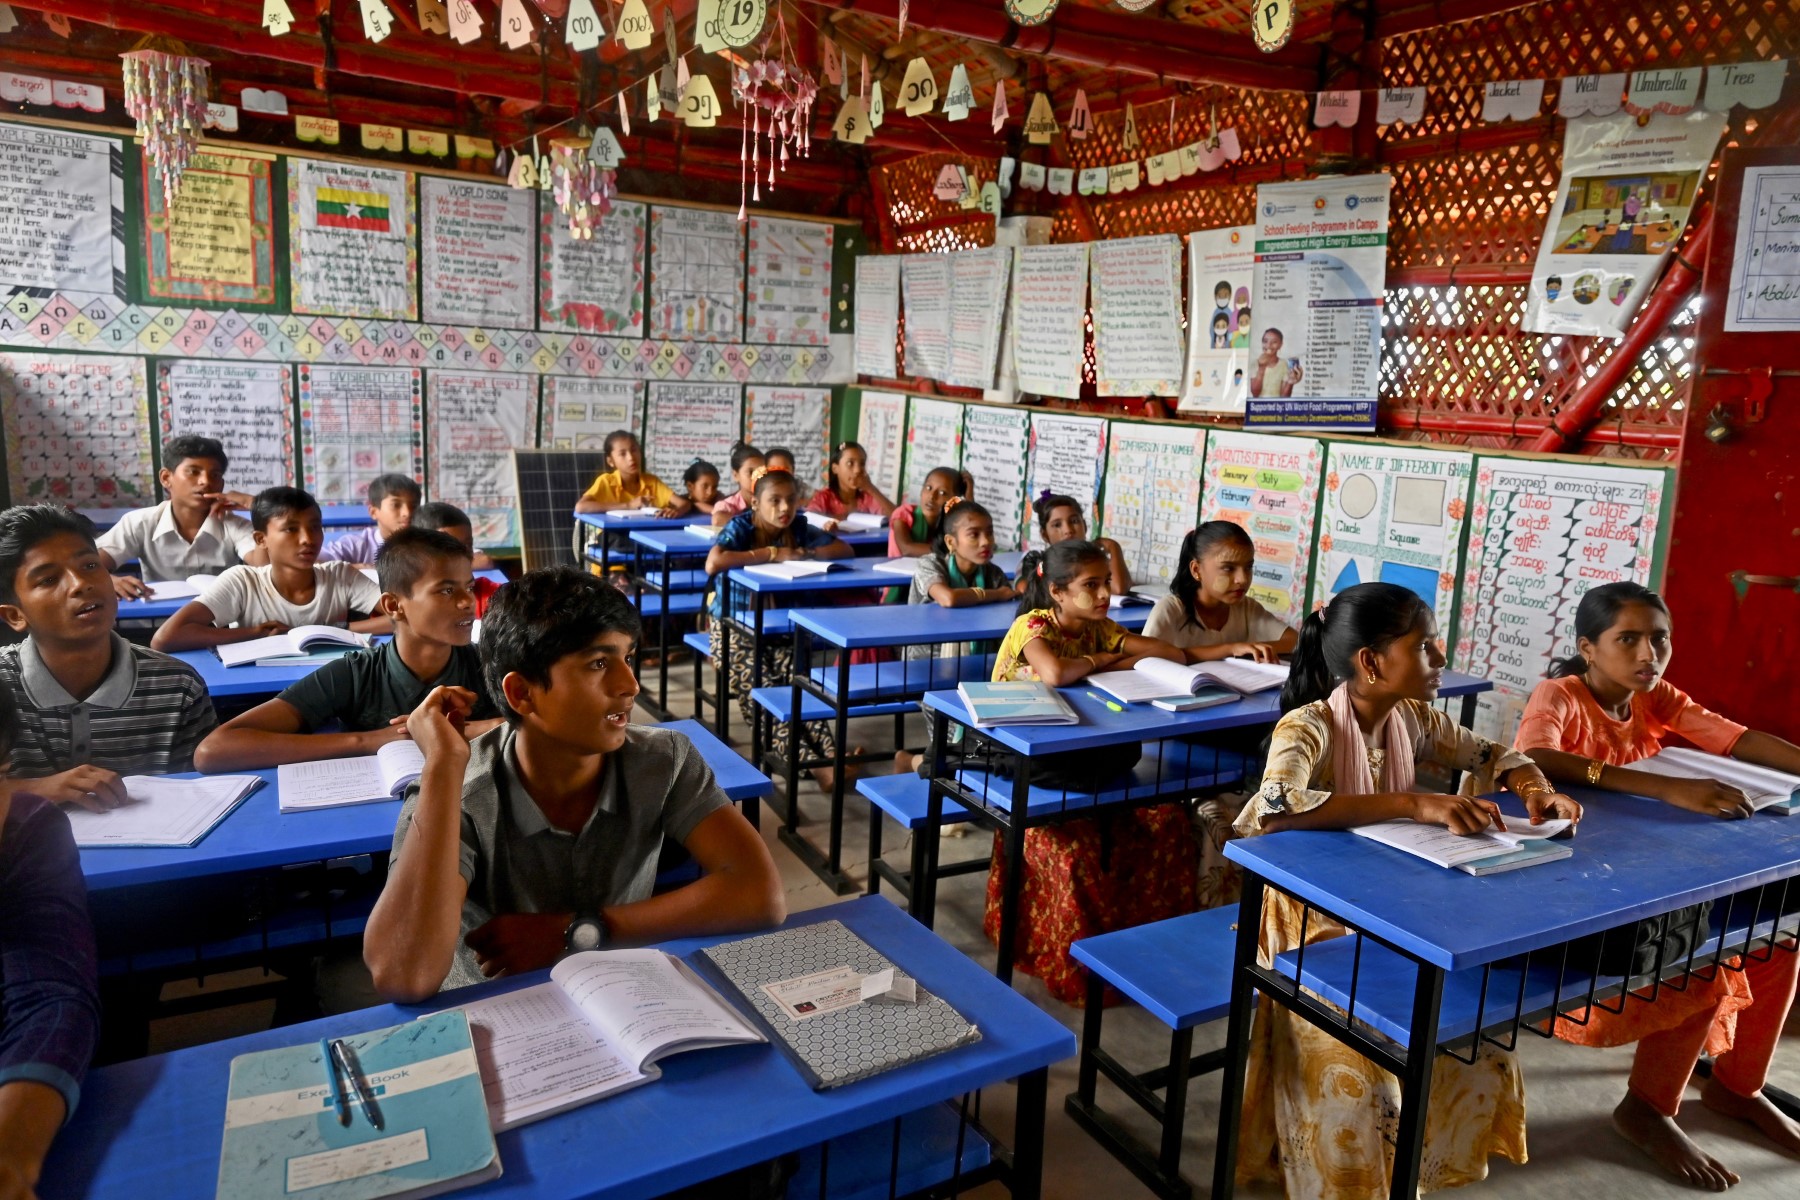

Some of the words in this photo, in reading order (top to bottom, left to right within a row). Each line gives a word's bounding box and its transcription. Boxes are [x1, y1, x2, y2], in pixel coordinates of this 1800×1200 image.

[1264, 2, 1279, 30] P
[1634, 71, 1687, 93] Umbrella
[1722, 66, 1755, 86] Tree
[1488, 82, 1521, 98] Jacket
[1575, 75, 1598, 94] Well
[1320, 91, 1349, 109] Whistle
[1384, 88, 1415, 110] Monkey
[448, 184, 484, 199] WORLD
[485, 190, 508, 201] SONG
[1360, 196, 1385, 204] CODEC
[1264, 224, 1284, 236] School
[1286, 223, 1310, 236] Feeding
[1311, 221, 1347, 235] Programme
[1348, 219, 1355, 229] in
[1356, 218, 1379, 231] Camps
[1264, 240, 1300, 253] Ingredients
[1301, 240, 1308, 249] of
[1309, 238, 1324, 250] High
[1326, 237, 1349, 248] Energy
[1351, 235, 1379, 245] Biscuits
[1, 318, 13, 331] A
[40, 324, 50, 336] B
[113, 330, 122, 342] D
[150, 332, 159, 343] E
[184, 336, 192, 347] F
[244, 337, 253, 348] H
[334, 344, 343, 354] K
[362, 345, 369, 356] L
[383, 347, 396, 358] M
[411, 348, 419, 360] N
[464, 351, 472, 362] P
[515, 353, 522, 364] R
[565, 356, 574, 367] T
[612, 360, 619, 370] V
[30, 362, 64, 375] SMALL
[70, 363, 112, 375] LETTER
[634, 362, 644, 372] W
[657, 362, 664, 372] X
[679, 362, 686, 372] Y
[1250, 402, 1276, 412] Supported
[1293, 402, 1308, 411] World
[1309, 402, 1321, 411] Food
[1323, 402, 1352, 413] Programme
[1119, 440, 1159, 452] COMPARISON
[1161, 443, 1170, 453] OF
[1172, 444, 1195, 456] NUMBER
[1278, 454, 1300, 469] YEAR
[1341, 454, 1372, 470] NAME
[1375, 457, 1388, 471] OF
[1390, 458, 1446, 476] DIFFERENT
[1222, 468, 1248, 483] January
[1261, 472, 1278, 488] July
[1221, 489, 1251, 506] February
[1259, 494, 1286, 510] August
[1255, 516, 1292, 532] September
[1336, 519, 1361, 534] Circle
[1390, 529, 1420, 546] Square
[371, 1069, 410, 1086] Book
